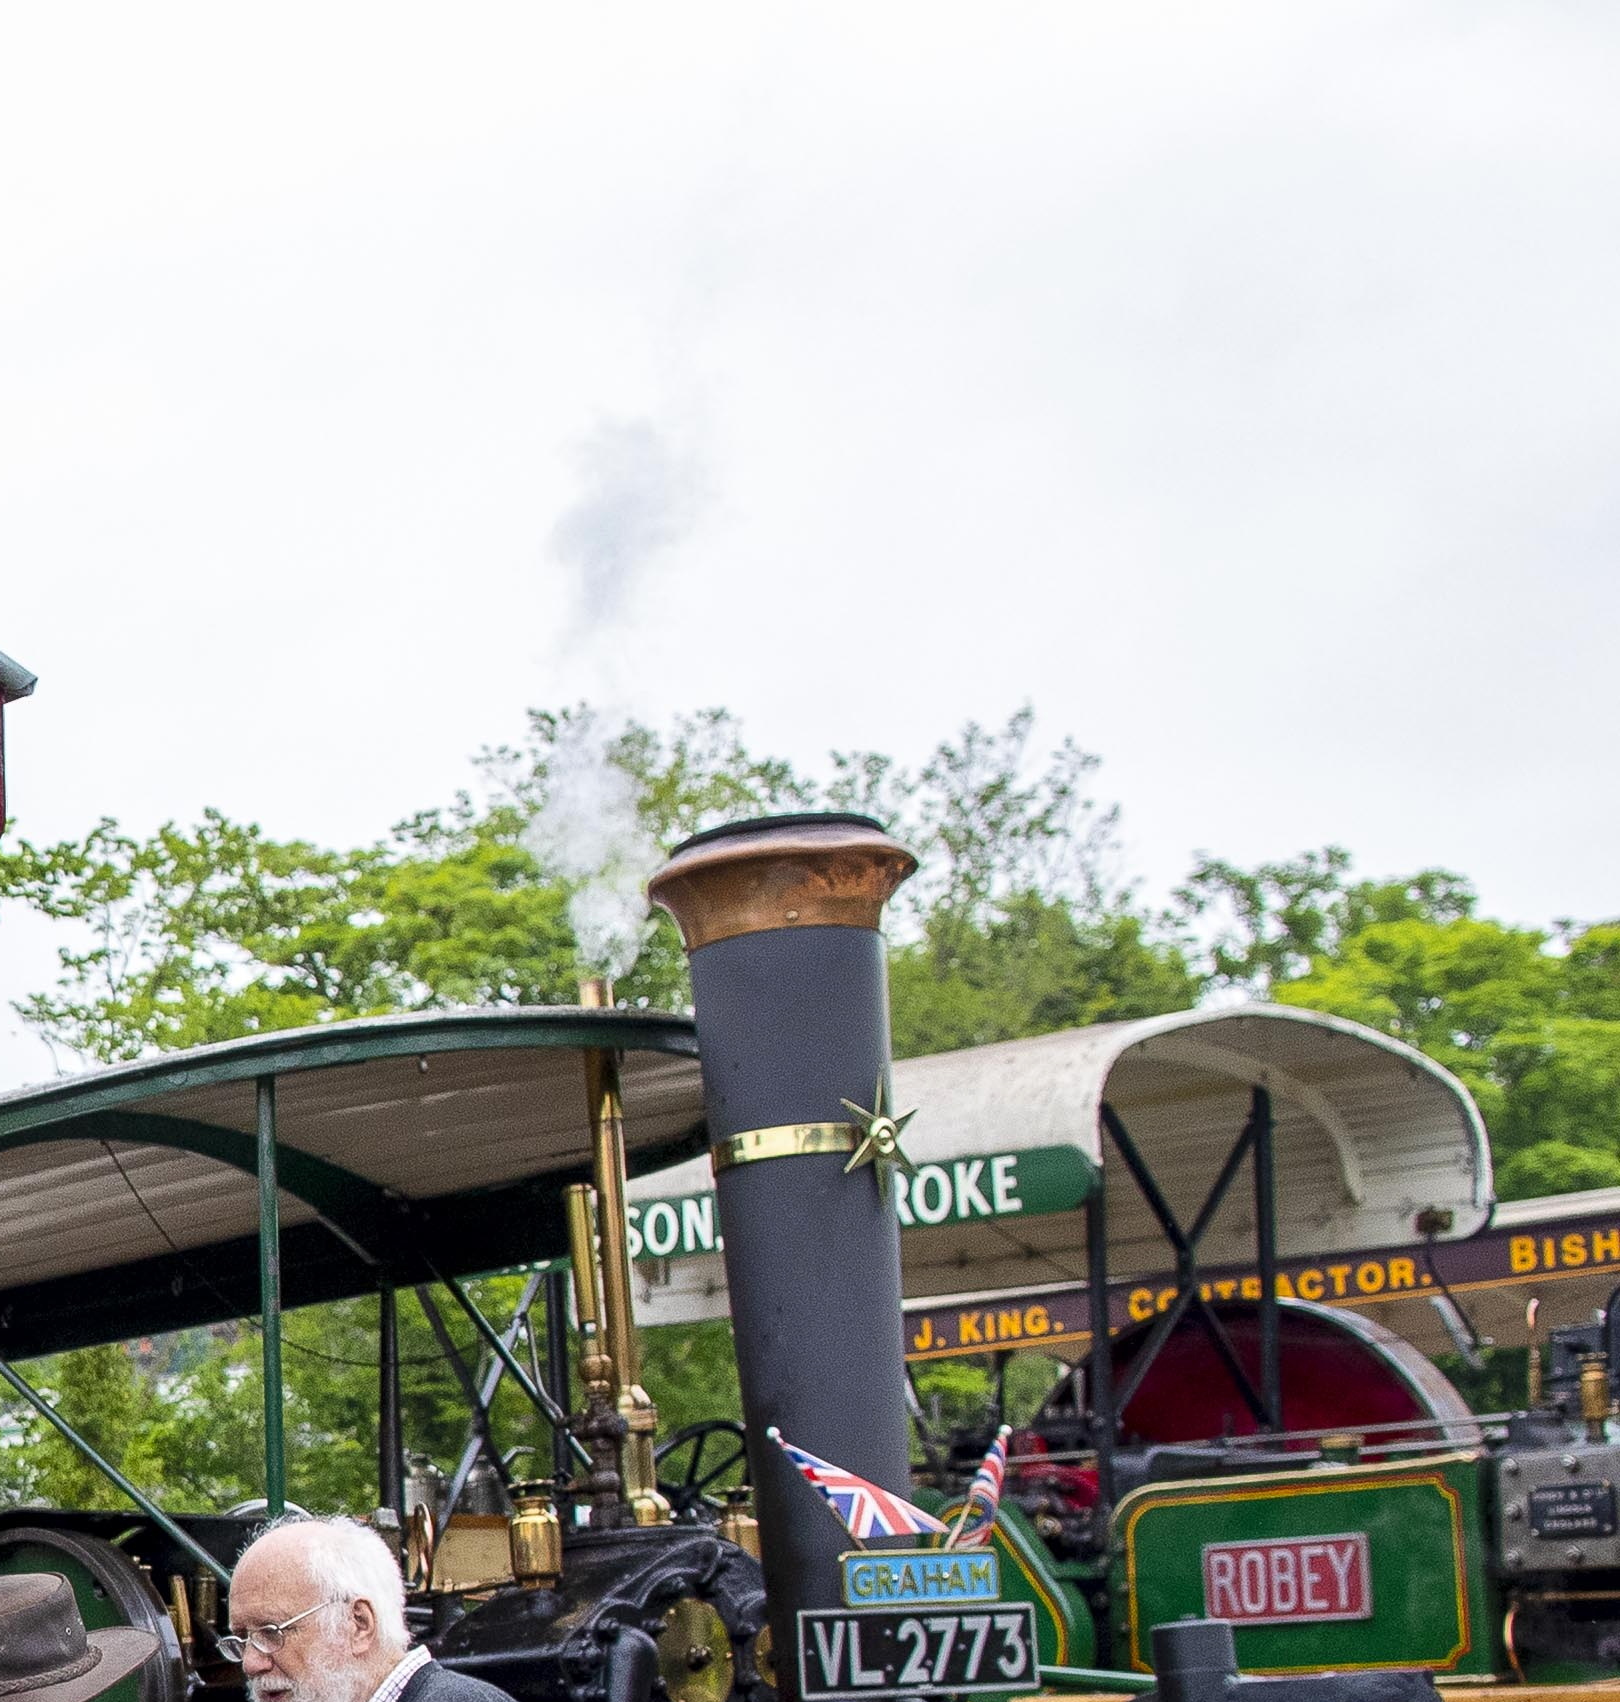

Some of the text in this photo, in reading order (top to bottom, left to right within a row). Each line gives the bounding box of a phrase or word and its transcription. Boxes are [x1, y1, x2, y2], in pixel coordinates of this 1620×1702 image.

[960, 1305, 1062, 1345] KING.
[852, 1561, 992, 1598] GRAHAM
[1210, 1543, 1356, 1616] ROBEY
[813, 1614, 1027, 1687] VL 2773
